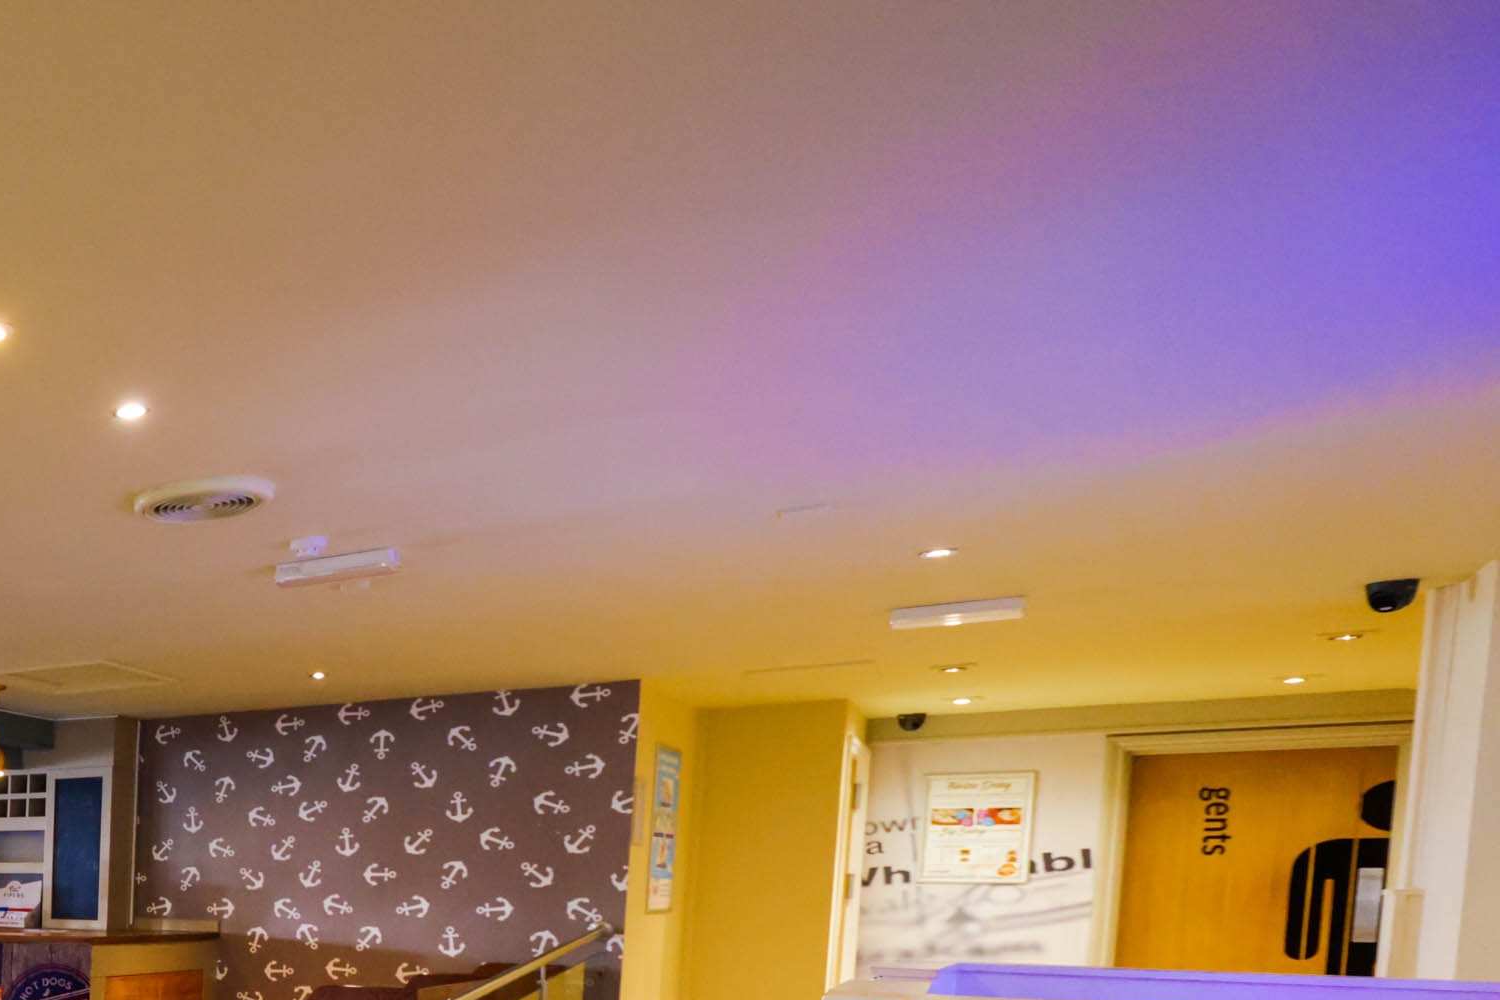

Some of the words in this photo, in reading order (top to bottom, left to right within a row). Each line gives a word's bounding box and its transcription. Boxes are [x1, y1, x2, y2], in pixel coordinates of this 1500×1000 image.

[1199, 786, 1232, 856] gents
[19, 981, 40, 1000] HOT
[41, 976, 73, 991] DOGS
